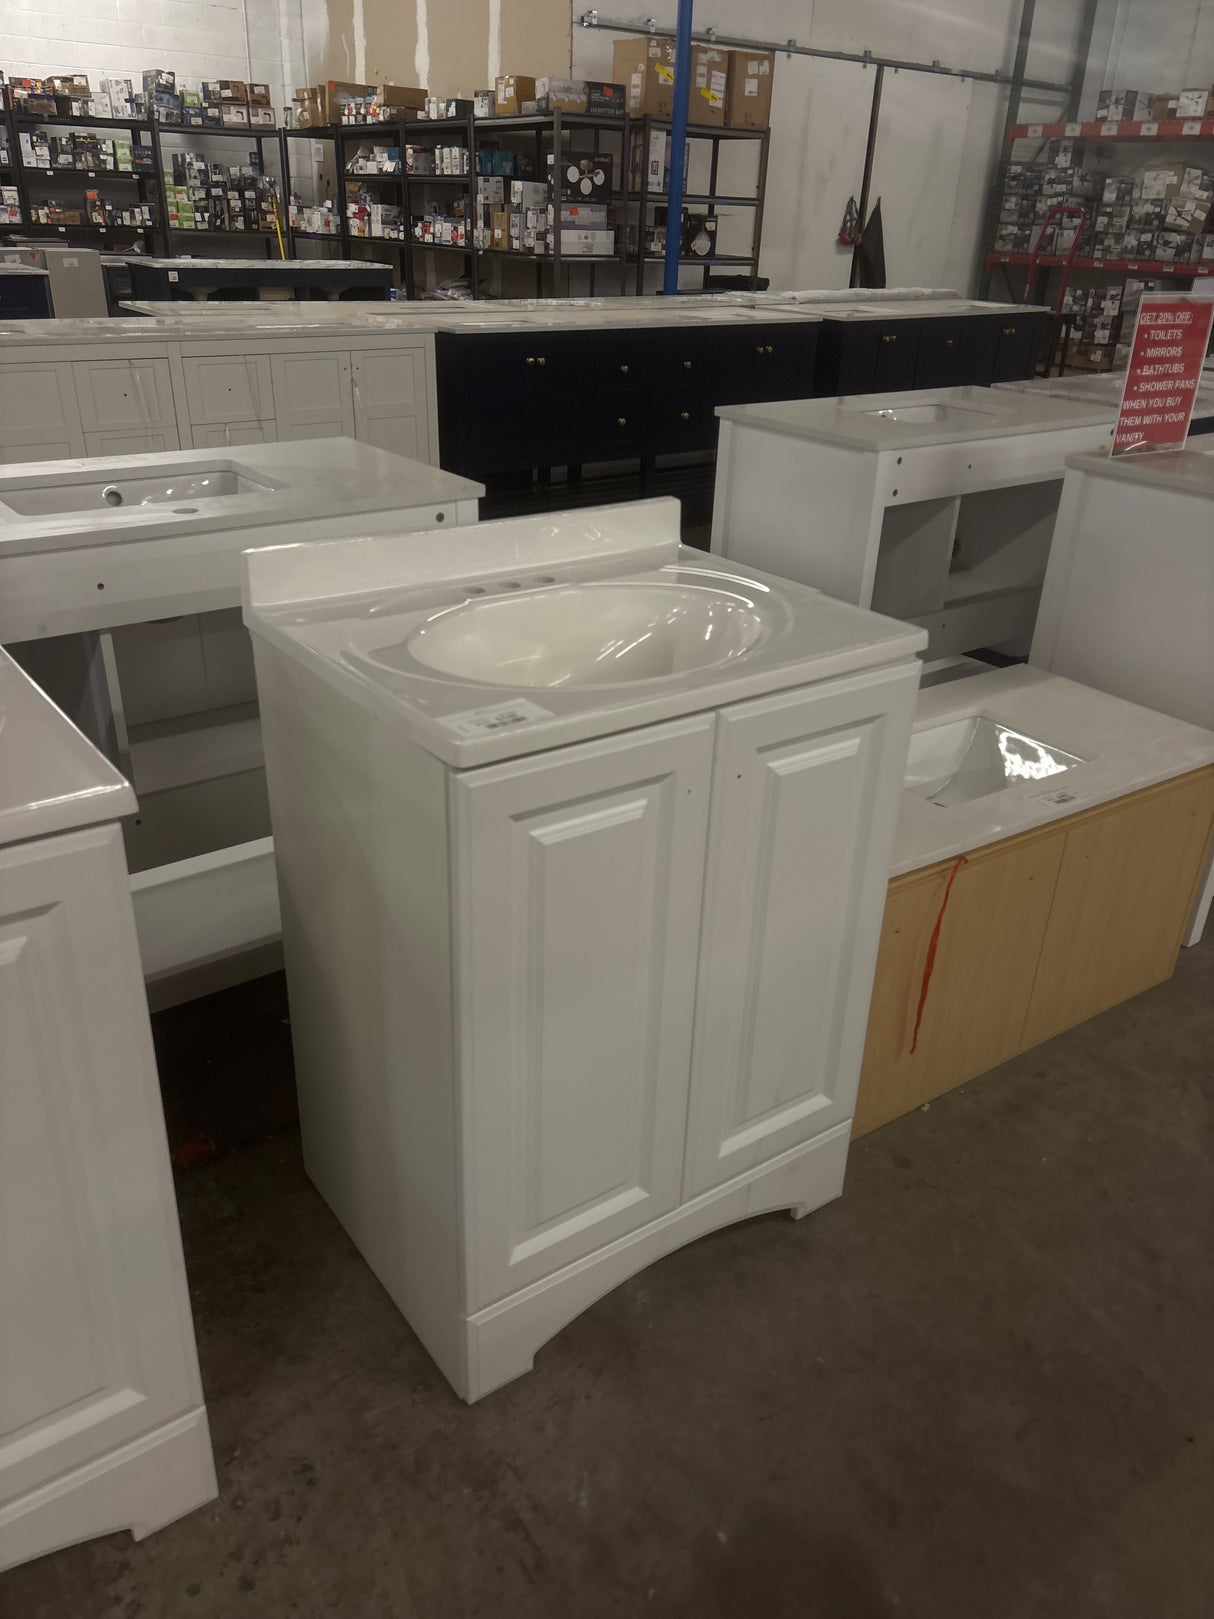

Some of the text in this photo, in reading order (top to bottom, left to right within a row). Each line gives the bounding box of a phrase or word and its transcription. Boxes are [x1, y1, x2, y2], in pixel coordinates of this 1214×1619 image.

[1140, 313, 1157, 323] GET
[1157, 312, 1174, 322] 20%
[1150, 330, 1182, 340] TOILETS
[1146, 347, 1183, 358] MIRRORS
[1143, 363, 1184, 375] BATHTUBS
[1139, 378, 1195, 392] SHOWER PANS
[1123, 396, 1183, 409] WHEN YOU BUY
[1119, 412, 1185, 426] THEM WITH YOUR
[1116, 432, 1145, 443] VANITY
